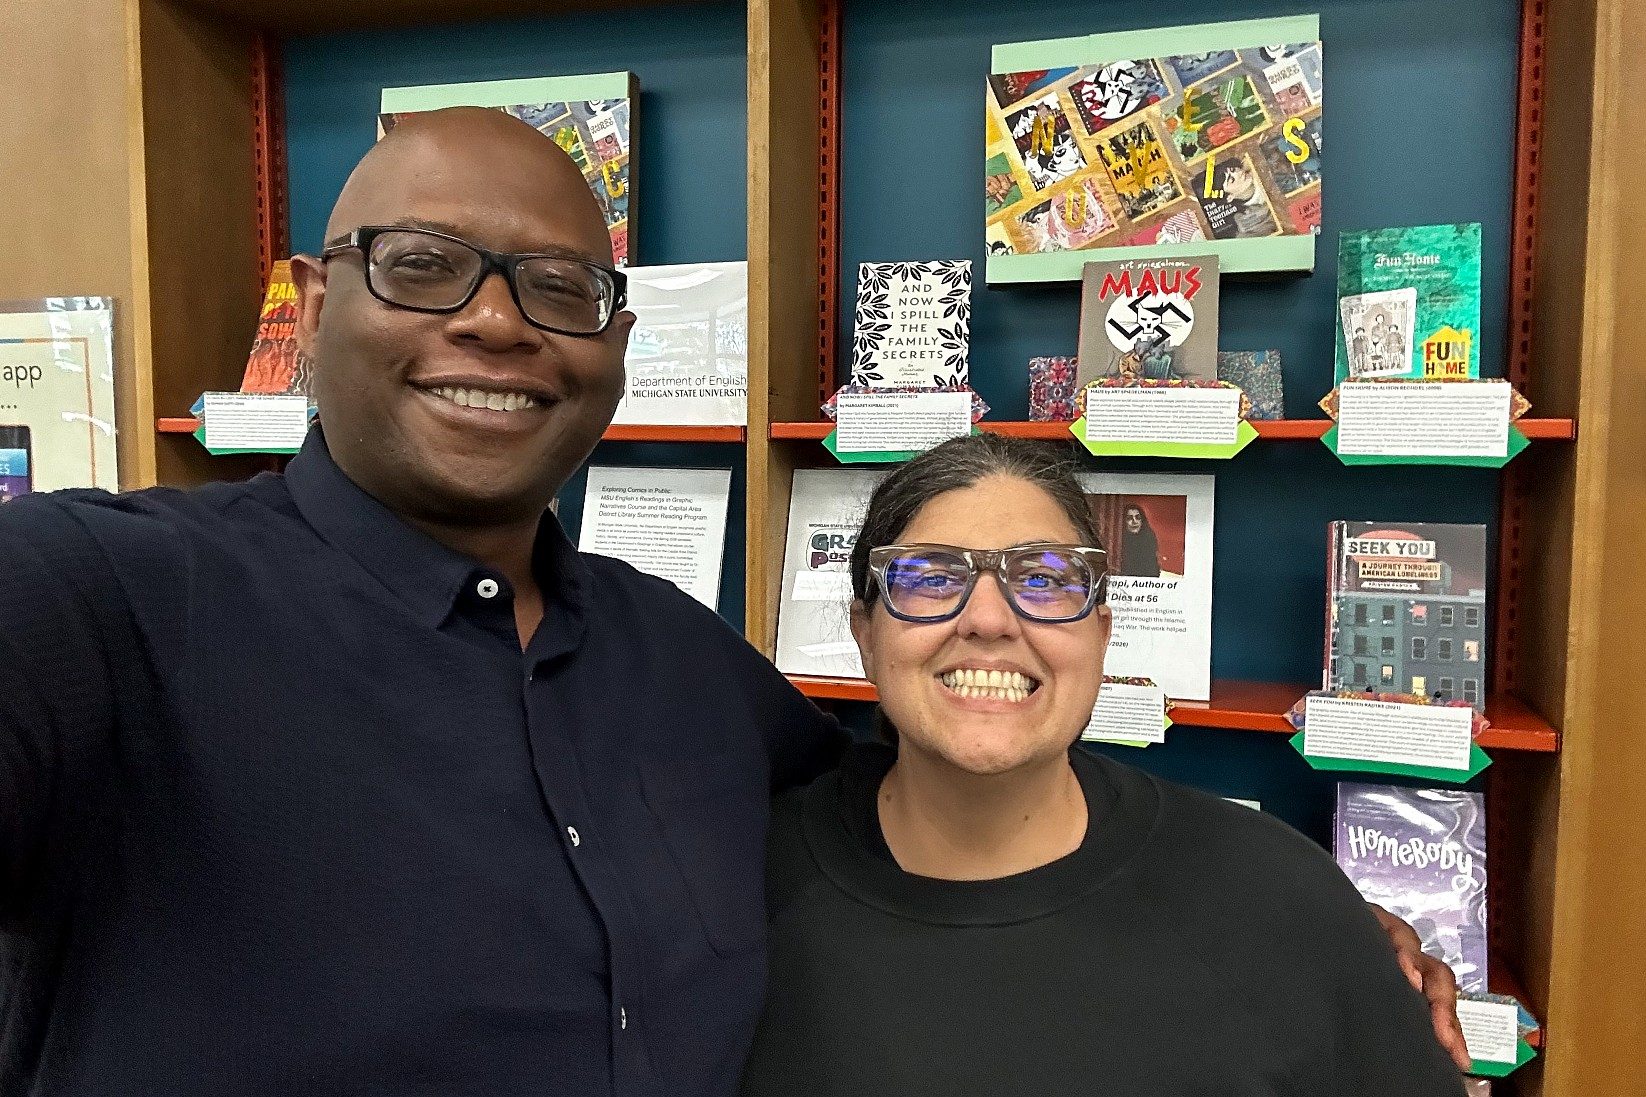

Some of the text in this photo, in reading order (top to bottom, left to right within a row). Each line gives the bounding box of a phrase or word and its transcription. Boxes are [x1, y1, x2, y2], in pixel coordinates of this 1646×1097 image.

[901, 284, 932, 293] AND
[1099, 266, 1202, 302] MAUS
[267, 282, 298, 300] PAR
[898, 297, 934, 306] NOW
[891, 311, 939, 319] I SPILL
[258, 322, 294, 340] SOW
[900, 324, 928, 332] THE
[888, 337, 939, 346] FAMILY
[882, 350, 943, 360] SECRETS
[1426, 341, 1466, 361] FUN
[3, 364, 42, 389] app
[632, 375, 747, 388] Department of English
[632, 388, 747, 398] MICHIGAN STATE UNIVERSITY
[811, 534, 858, 552] GRA
[1348, 541, 1431, 556] SEEK YOU
[1361, 569, 1396, 577] AMERICAN
[1132, 580, 1165, 588] Author
[1167, 581, 1178, 589] of
[1111, 592, 1133, 602] Dies
[1146, 595, 1159, 603] 56
